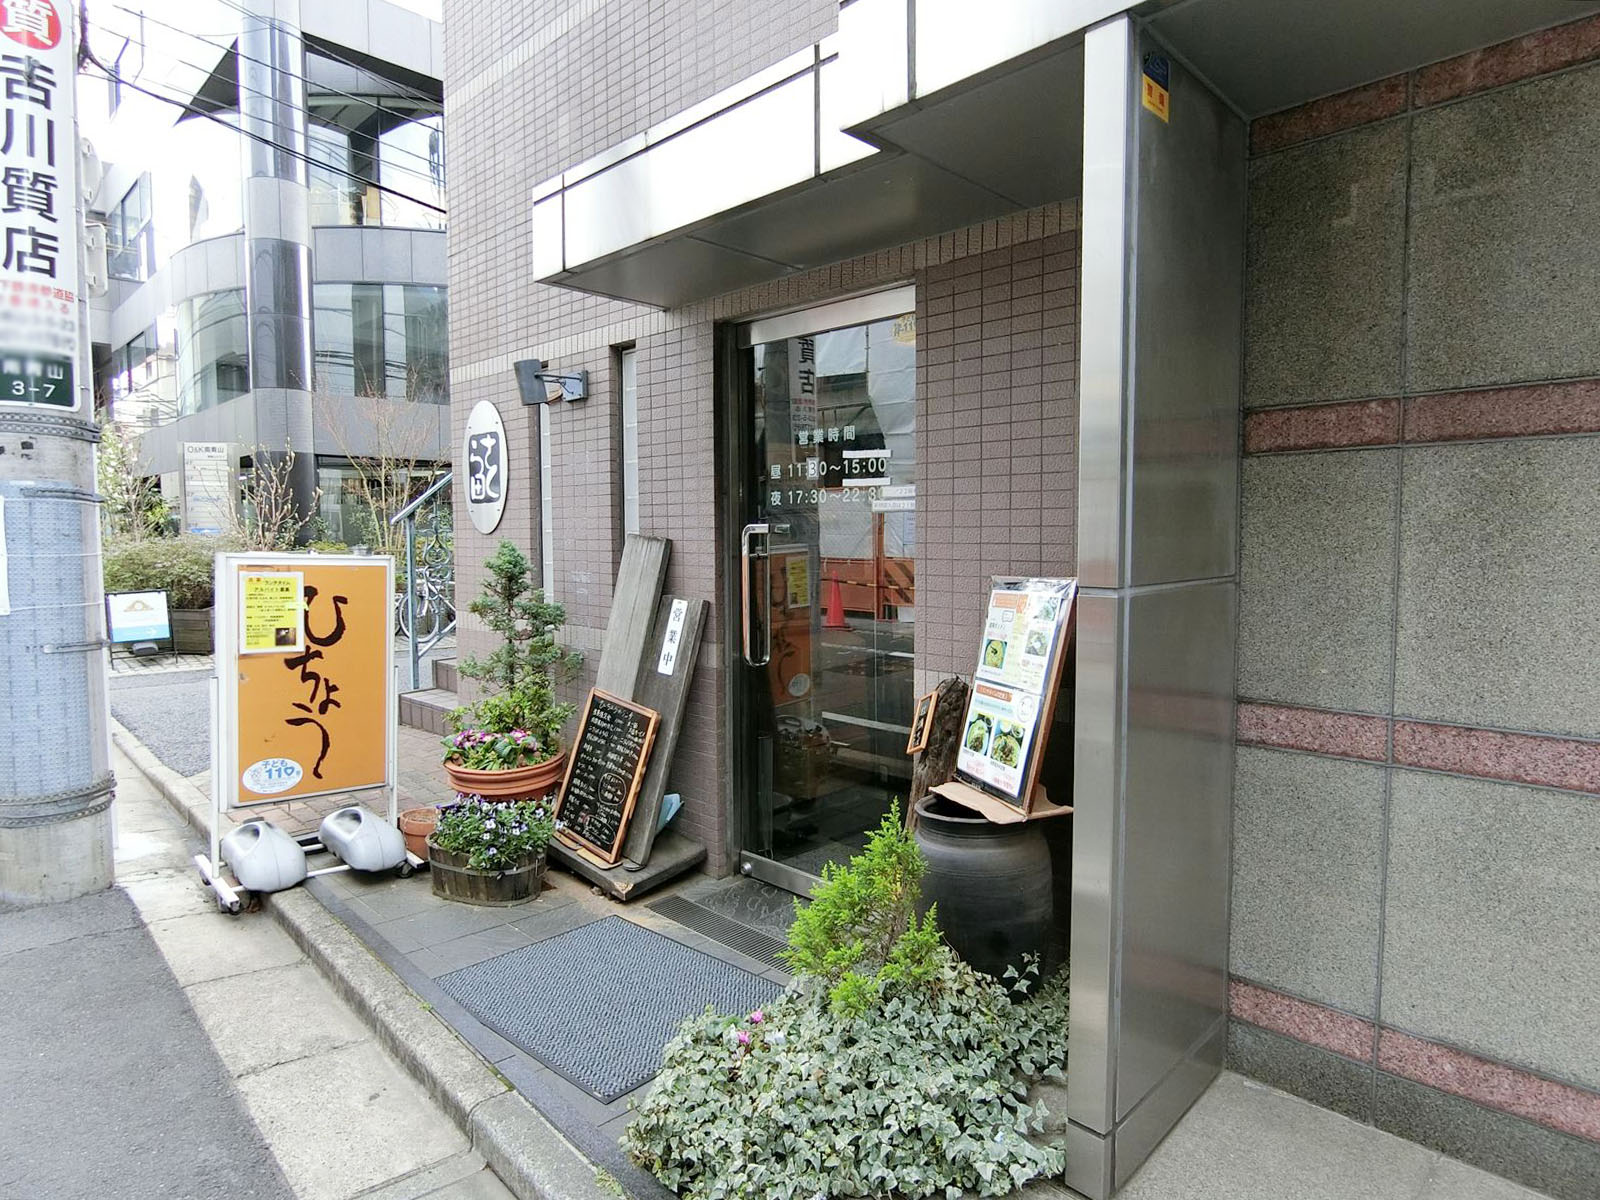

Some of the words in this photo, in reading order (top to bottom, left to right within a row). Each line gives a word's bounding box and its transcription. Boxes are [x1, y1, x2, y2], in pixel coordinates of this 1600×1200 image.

[0, 54, 59, 279] 吉川質店
[798, 425, 856, 445] 営業時間
[770, 464, 782, 480] 昼
[770, 491, 782, 507] 夜
[663, 608, 684, 666] 営業中
[284, 585, 348, 779] ひちょう
